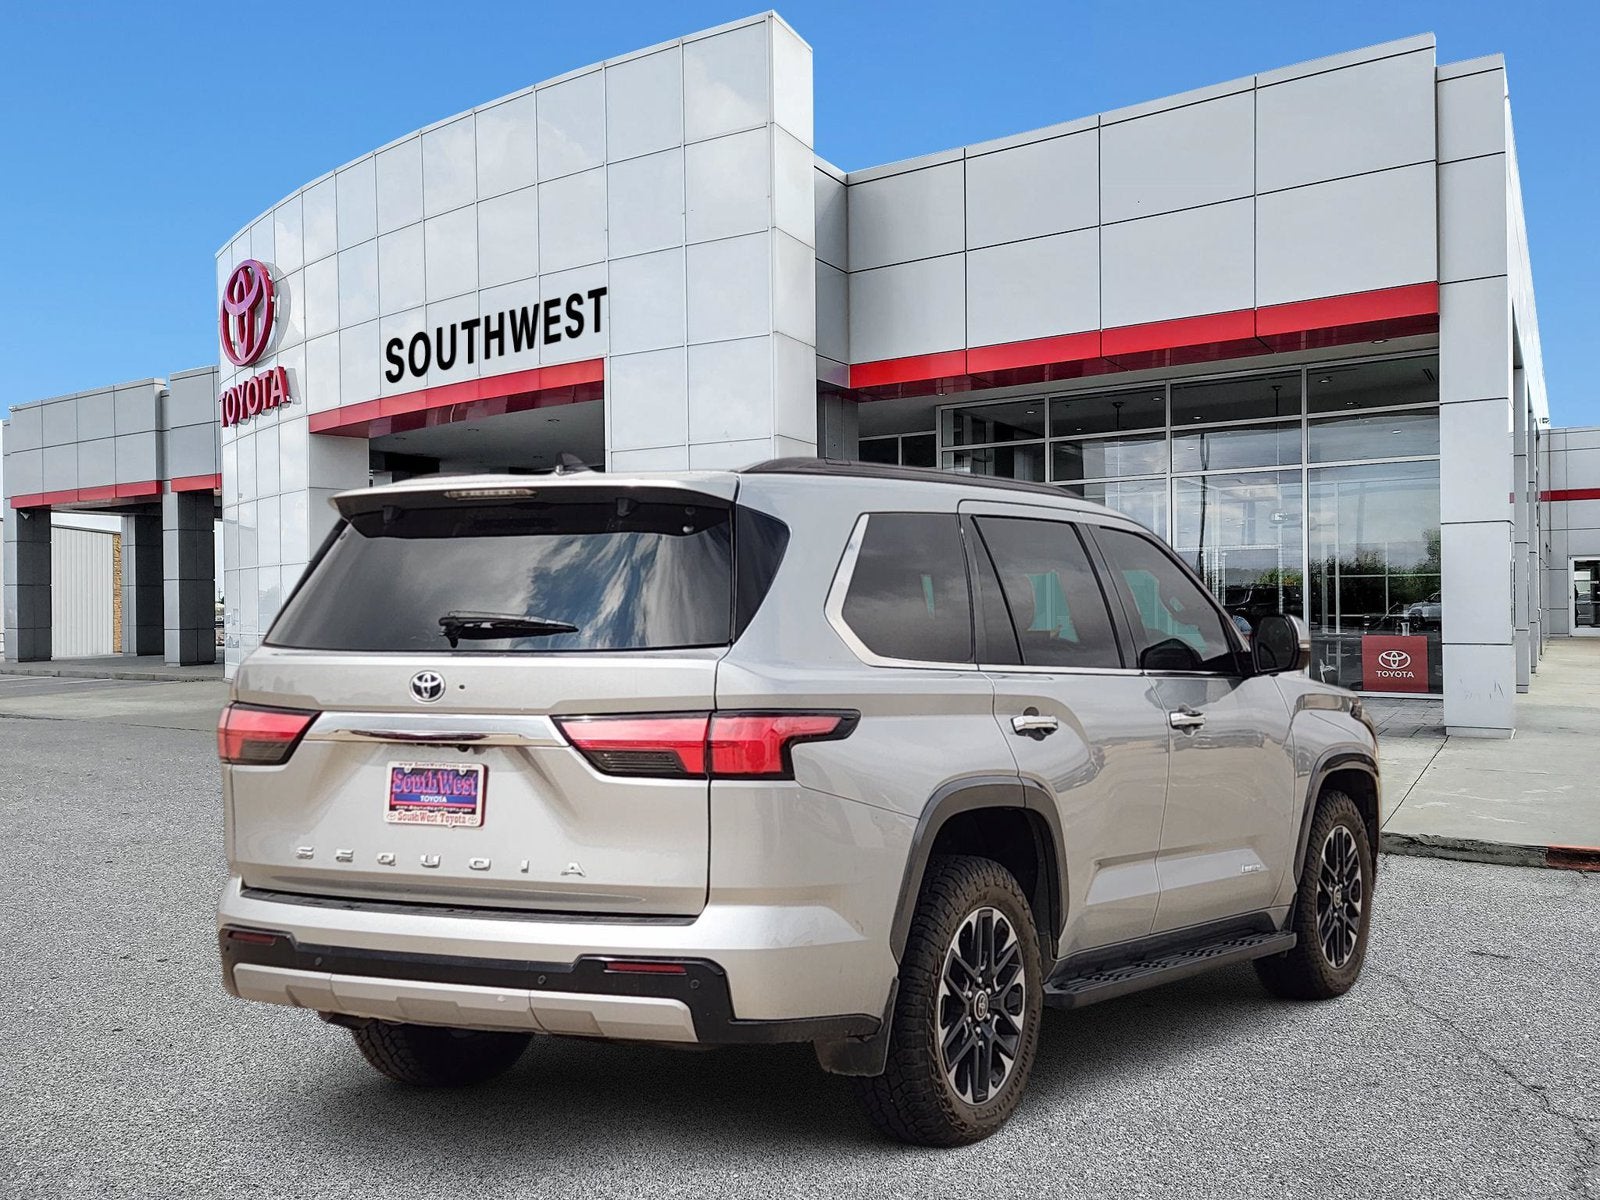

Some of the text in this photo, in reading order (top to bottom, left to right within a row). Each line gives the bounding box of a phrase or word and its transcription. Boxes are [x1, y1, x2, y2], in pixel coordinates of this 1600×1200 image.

[385, 286, 608, 384] SOUTHWEST
[217, 366, 291, 428] TOYOTA
[1376, 670, 1414, 678] TOYOTA
[420, 795, 448, 803] TOYOTA
[440, 812, 467, 826] Toyota
[295, 846, 586, 878] SEQUOIA
